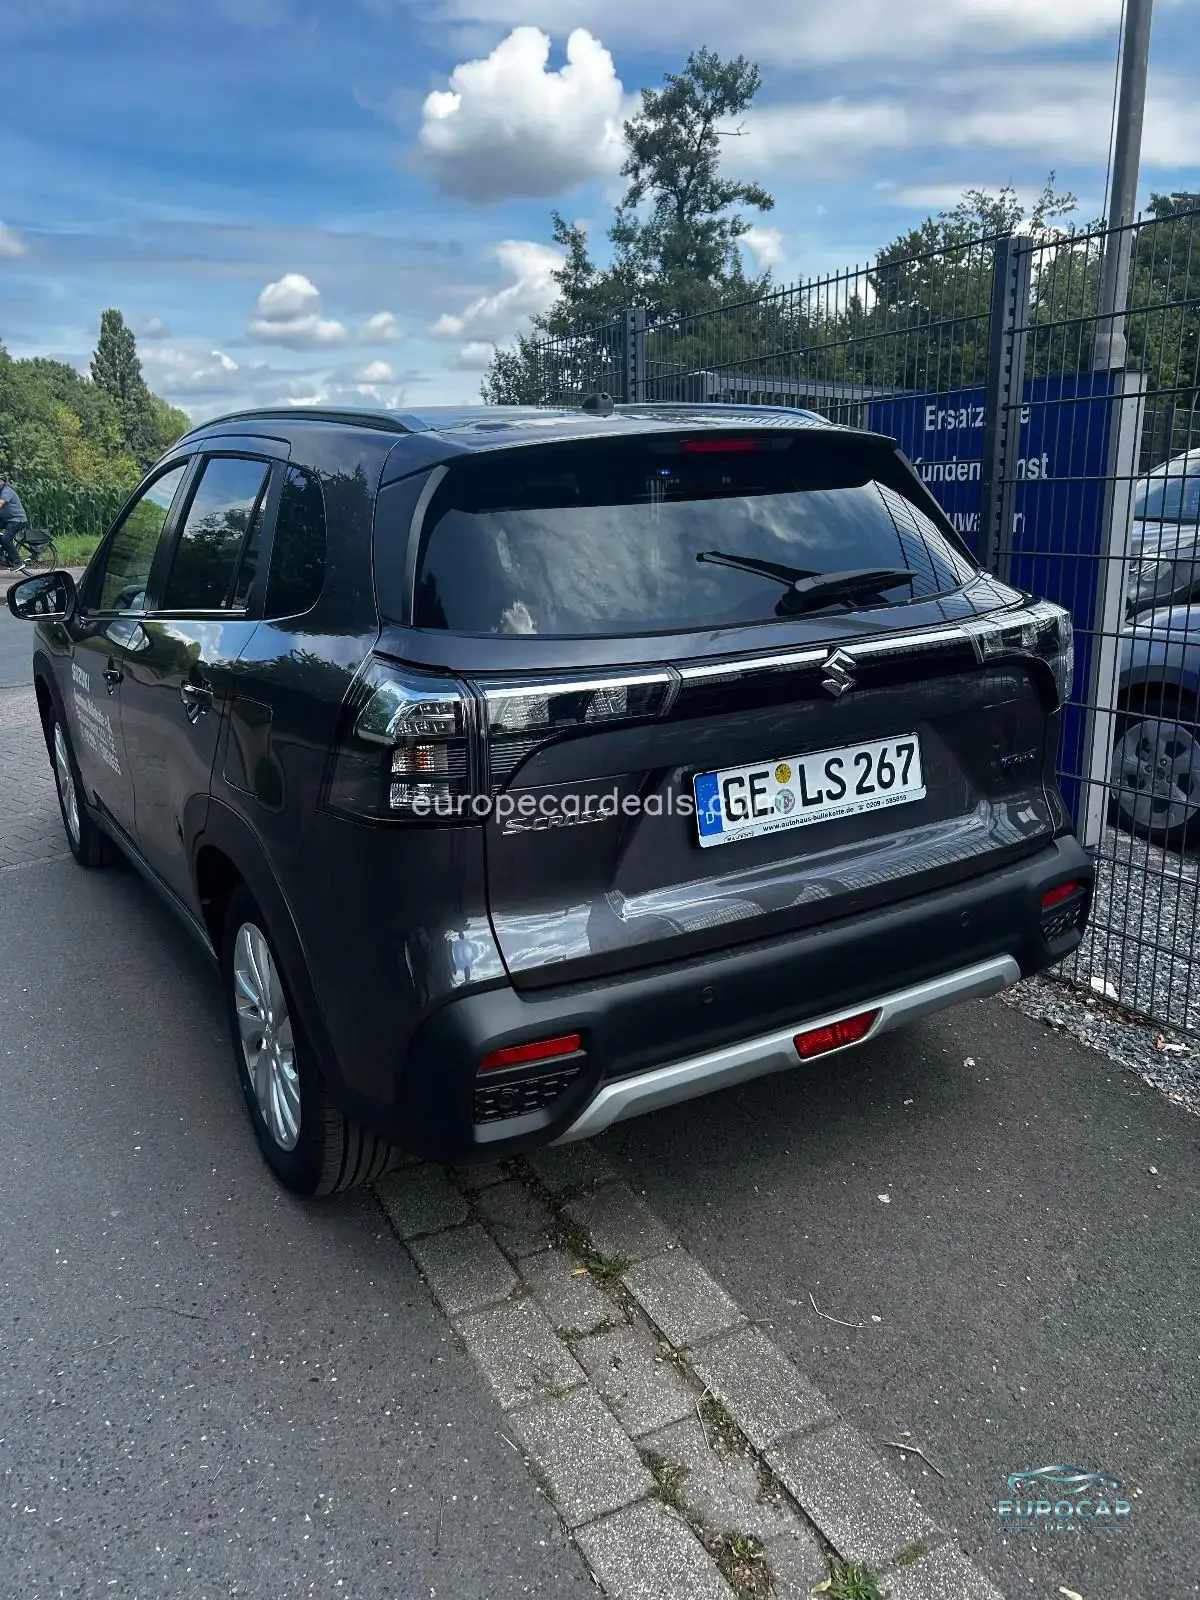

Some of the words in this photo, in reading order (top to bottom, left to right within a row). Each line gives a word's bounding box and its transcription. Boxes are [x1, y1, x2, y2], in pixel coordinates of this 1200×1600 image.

[925, 402, 1031, 430] Ersatze
[909, 452, 1049, 481] Kundennst
[723, 770, 775, 822] GE
[798, 757, 846, 807] LS
[853, 742, 915, 796] 267
[502, 807, 611, 836] S-CROSS
[706, 811, 715, 825] D
